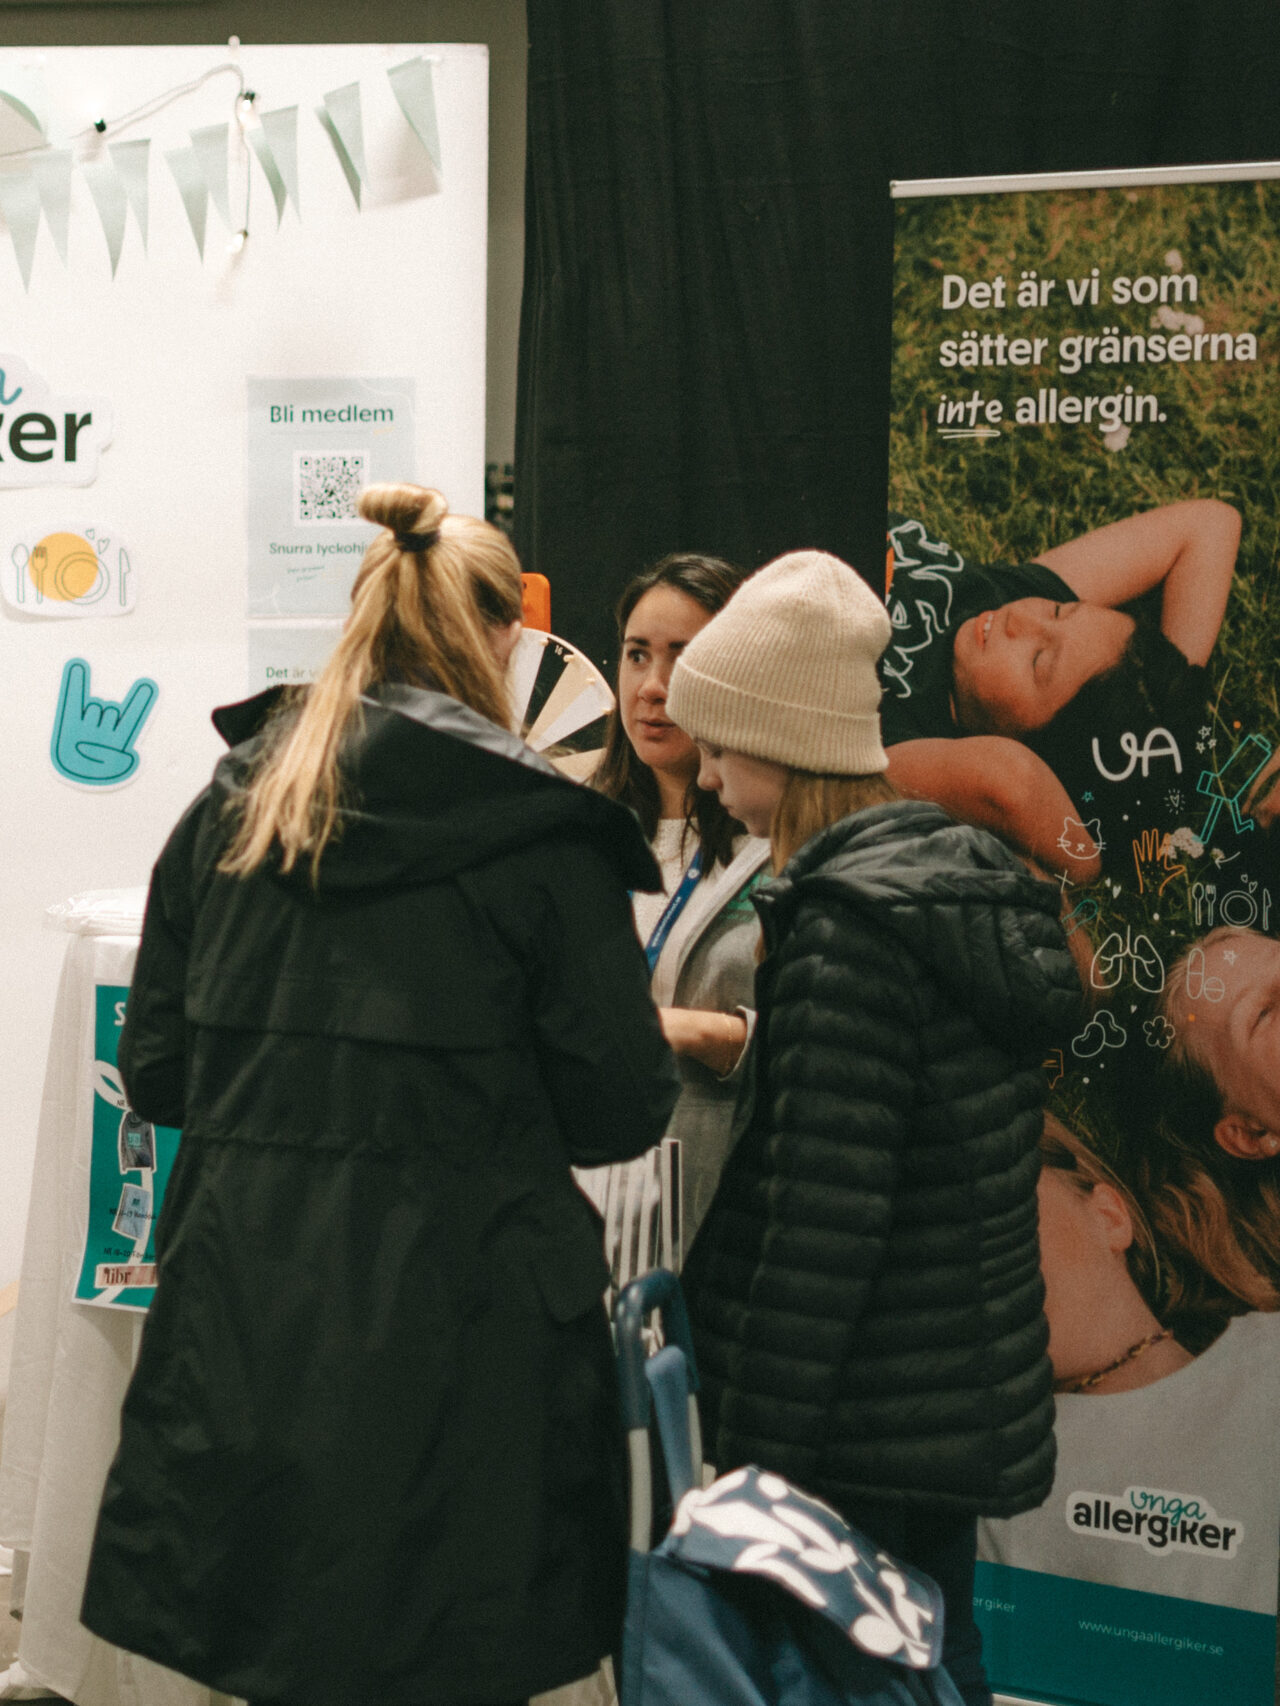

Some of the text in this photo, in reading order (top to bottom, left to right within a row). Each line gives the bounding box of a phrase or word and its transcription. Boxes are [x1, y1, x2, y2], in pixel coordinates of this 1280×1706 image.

[942, 267, 1199, 310] Det är vi som
[938, 326, 1258, 375] sätter gränserna
[269, 404, 395, 424] Bli medlem
[936, 385, 1168, 433] inte allergin.
[269, 541, 369, 557] Snurra lyckohj
[553, 643, 564, 656] 16
[265, 666, 289, 679] Det
[1072, 1499, 1237, 1551] allergiker
[1130, 1490, 1208, 1527] unga
[971, 1596, 1018, 1615] ergiker
[1078, 1619, 1225, 1657] www.ungaallergiker.se
